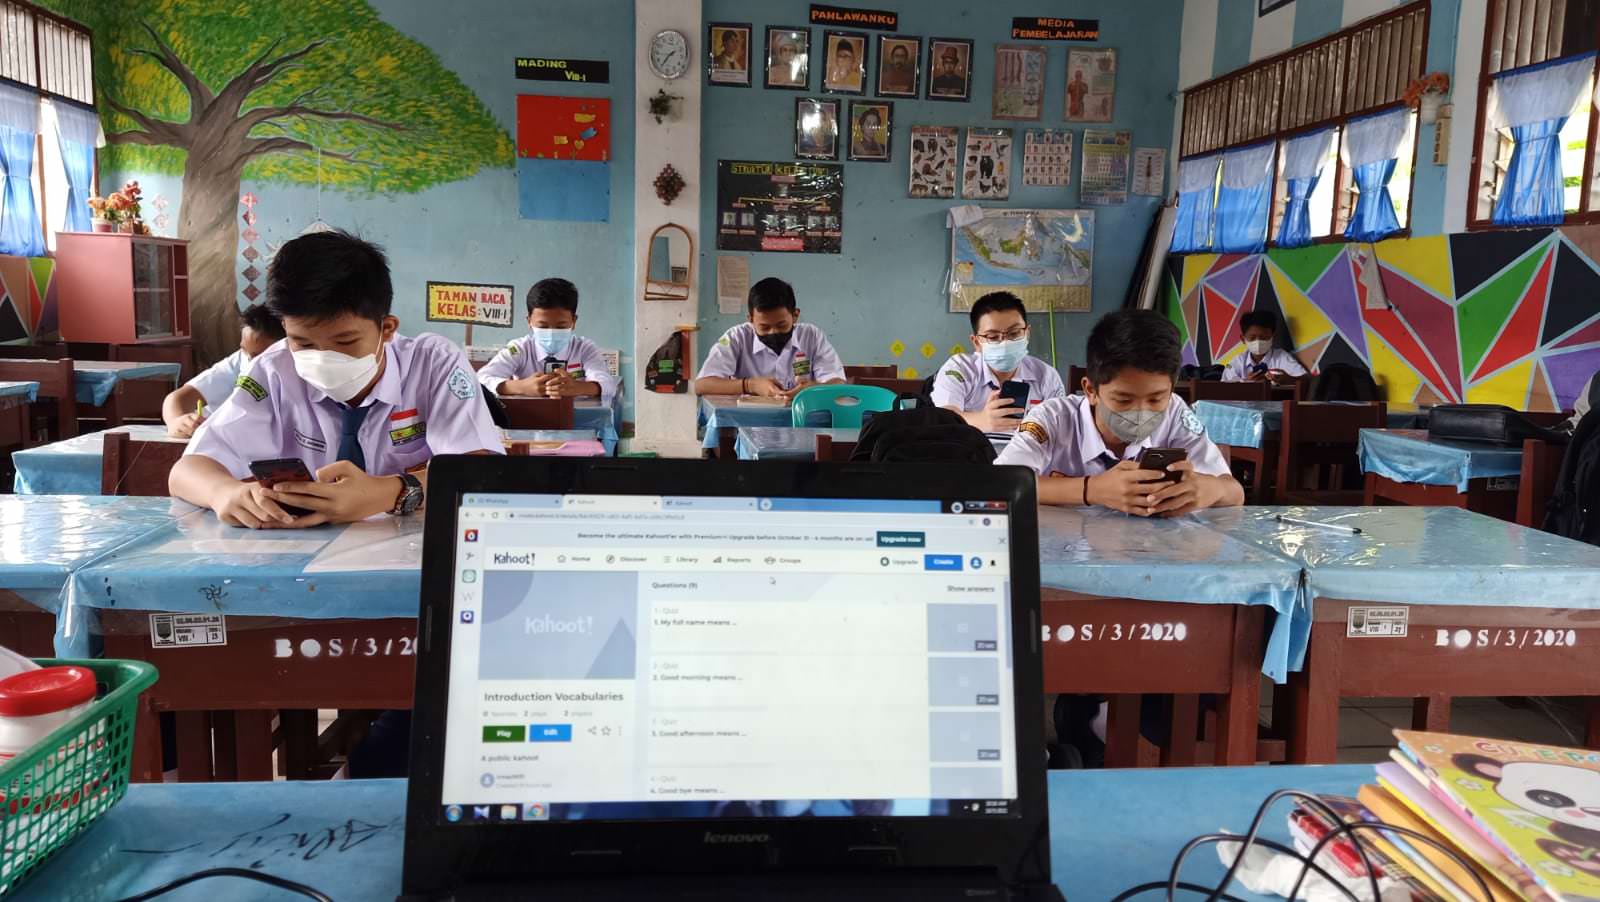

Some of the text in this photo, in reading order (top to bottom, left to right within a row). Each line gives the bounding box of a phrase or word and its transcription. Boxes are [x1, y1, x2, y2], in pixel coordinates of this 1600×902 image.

[811, 10, 897, 25] PAHLAWANKU
[1037, 18, 1075, 28] MEDIA
[1012, 28, 1099, 39] PEMBELAJARAN
[517, 59, 567, 69] MADING
[437, 290, 506, 305] TAMAN BACA
[493, 552, 536, 566] Kahoot!
[651, 582, 688, 590] Questions
[524, 614, 593, 636] Kahoot!
[484, 692, 625, 702] Introduction Vocabularies
[496, 730, 512, 739] Play
[704, 831, 769, 844] lenovo
